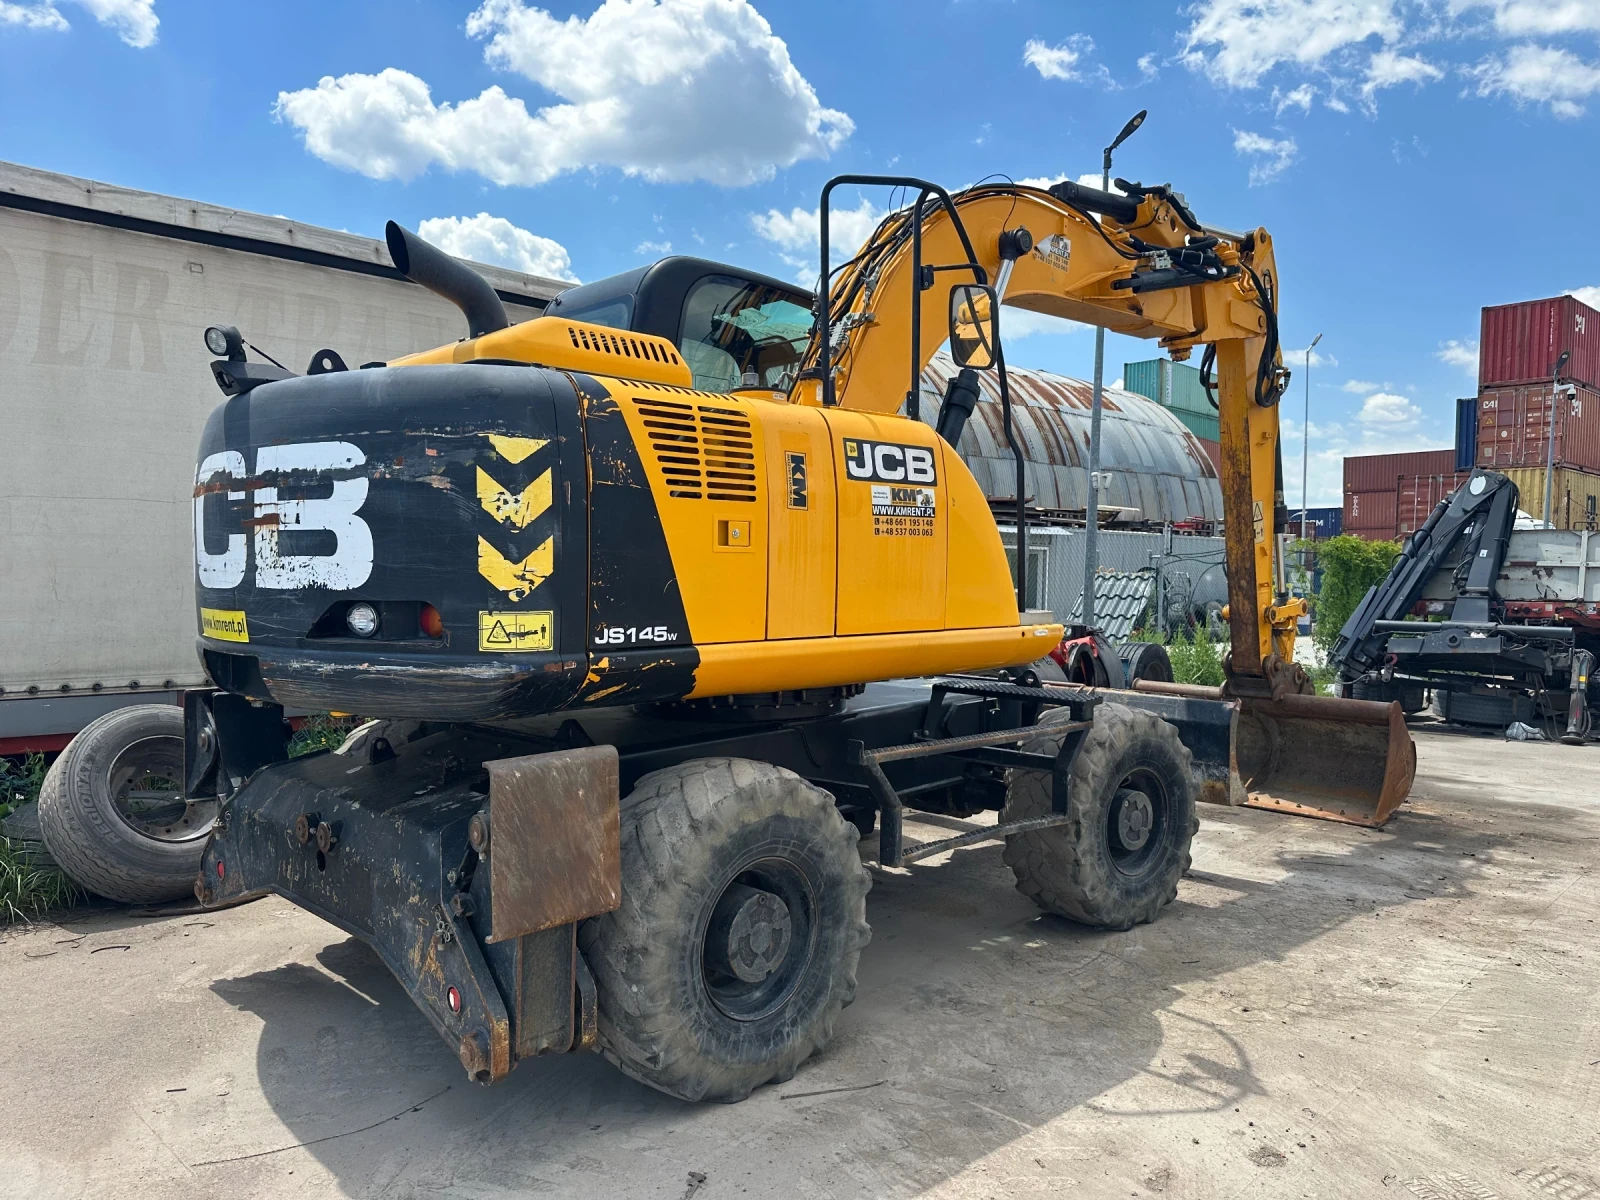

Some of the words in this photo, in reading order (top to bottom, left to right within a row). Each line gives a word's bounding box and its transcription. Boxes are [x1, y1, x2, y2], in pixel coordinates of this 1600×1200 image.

[1483, 400, 1498, 409] CAI
[848, 443, 935, 483] JCB
[790, 454, 806, 508] KM
[892, 488, 916, 502] KM
[192, 440, 374, 591] CB
[872, 506, 935, 517] WWW.KMRENT.PL
[881, 518, 894, 526] +48
[909, 519, 920, 527] 195
[881, 528, 894, 536] +48
